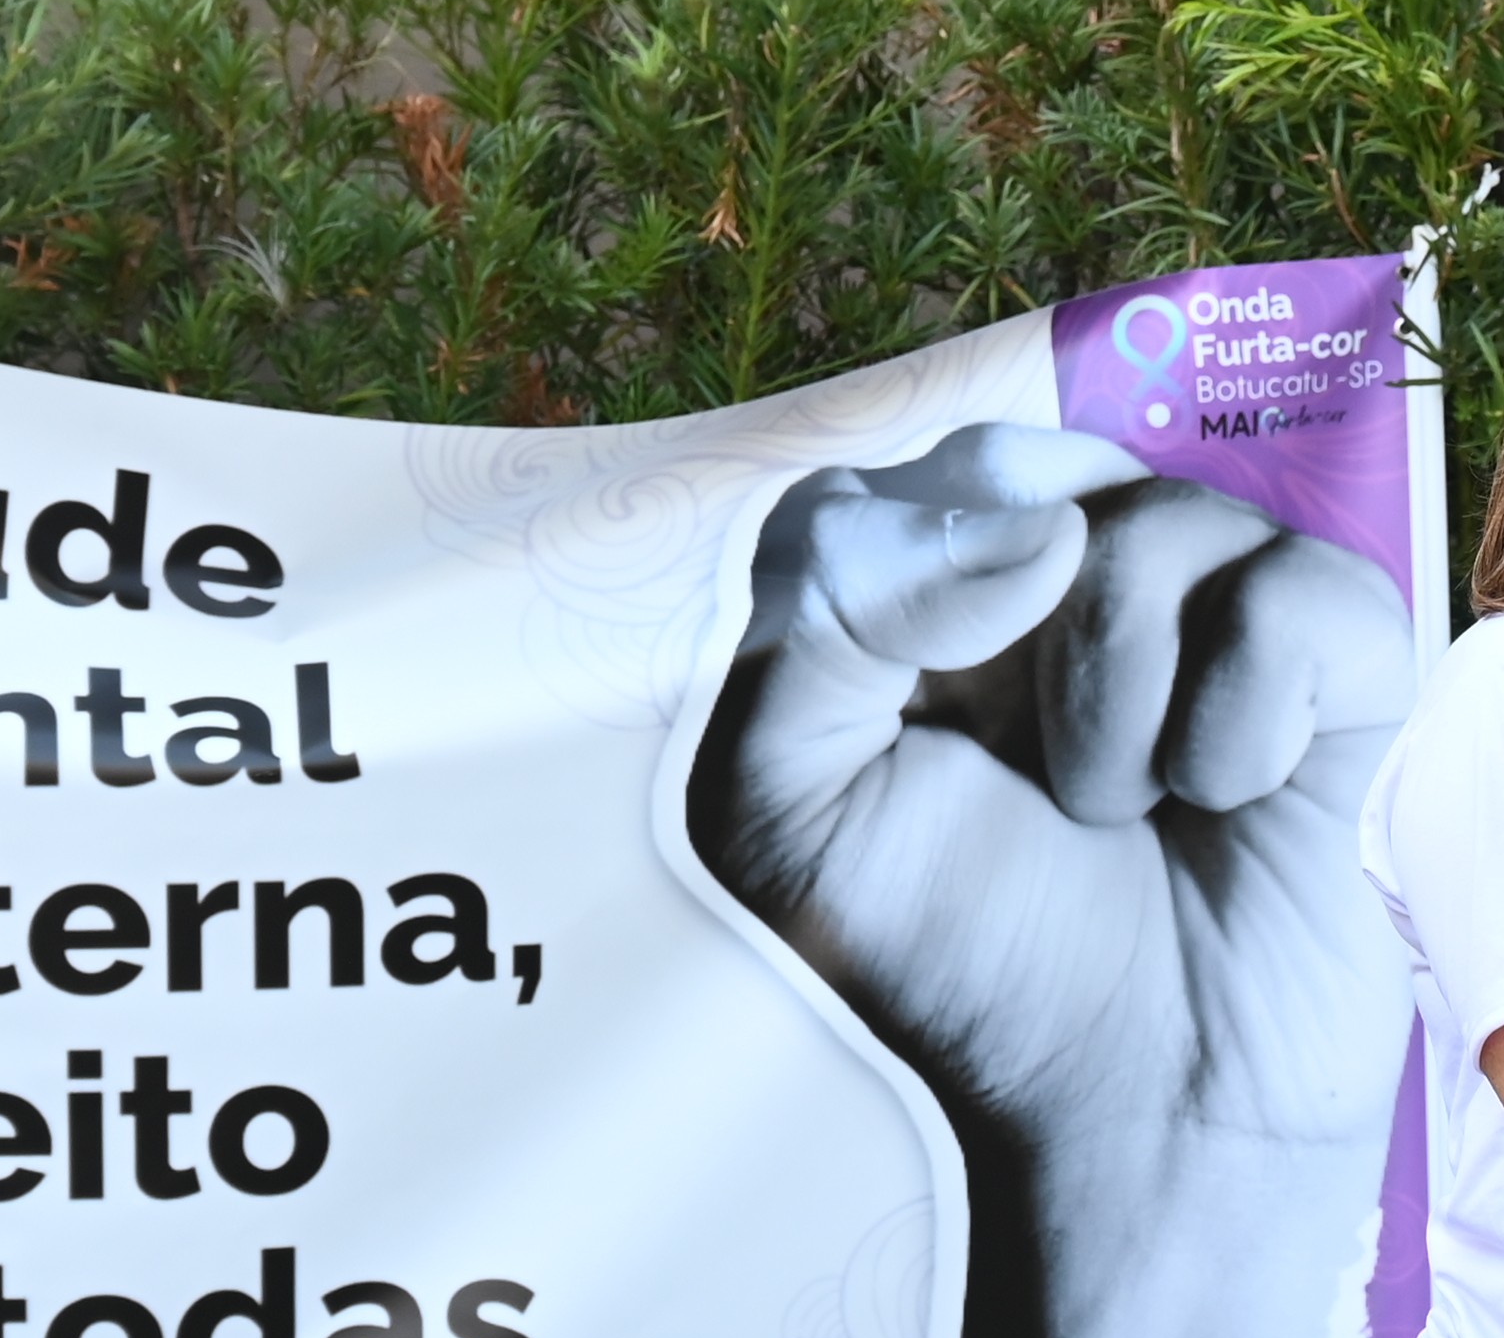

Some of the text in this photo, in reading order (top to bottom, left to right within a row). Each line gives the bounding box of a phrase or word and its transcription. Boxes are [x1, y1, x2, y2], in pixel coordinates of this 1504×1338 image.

[1187, 287, 1294, 326] Onda
[1192, 329, 1369, 368] Furta-cor
[1197, 369, 1328, 404] Botucatu
